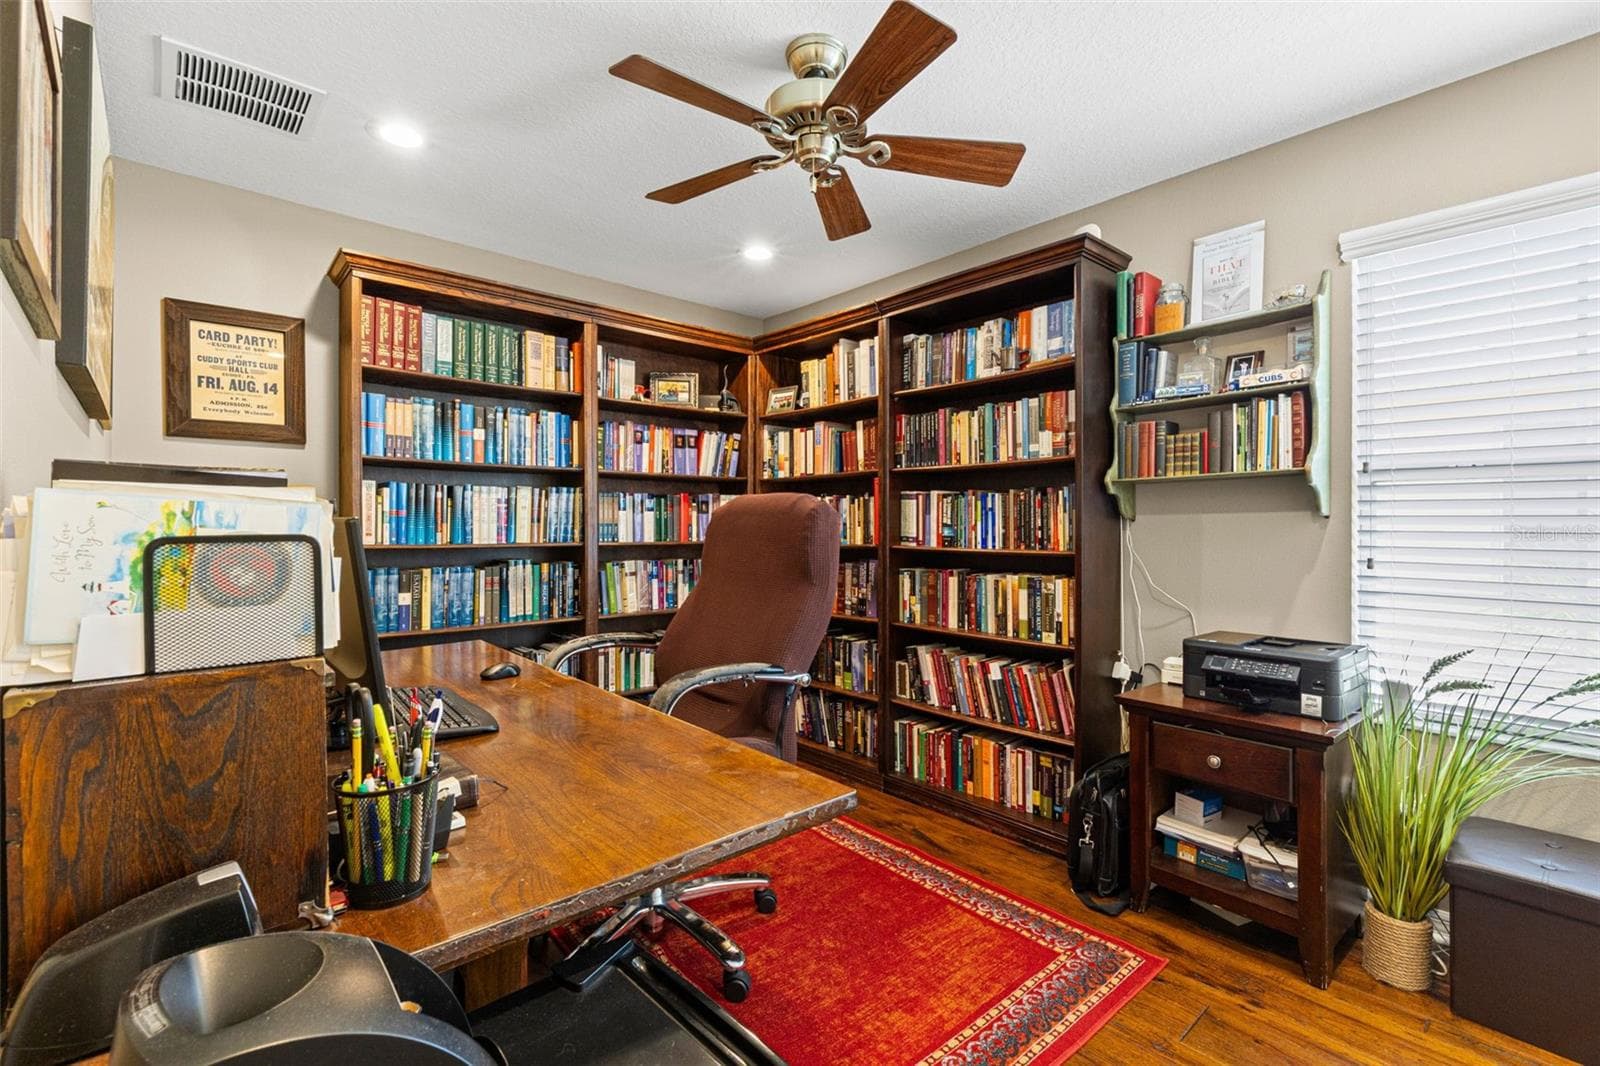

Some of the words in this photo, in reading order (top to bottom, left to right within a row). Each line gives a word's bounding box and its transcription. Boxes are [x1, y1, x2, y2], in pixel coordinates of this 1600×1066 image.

[198, 329, 230, 343] CARD
[236, 333, 278, 349] PARTY!
[197, 354, 224, 364] CUDDY
[226, 358, 258, 368] SPORTS
[259, 362, 279, 370] CLUB
[228, 365, 249, 374] HALL
[197, 375, 224, 390] FRI.
[229, 379, 259, 394] AUG.
[263, 382, 279, 395] 14
[1258, 373, 1283, 383] CUBS
[413, 574, 421, 599] ISAIAH
